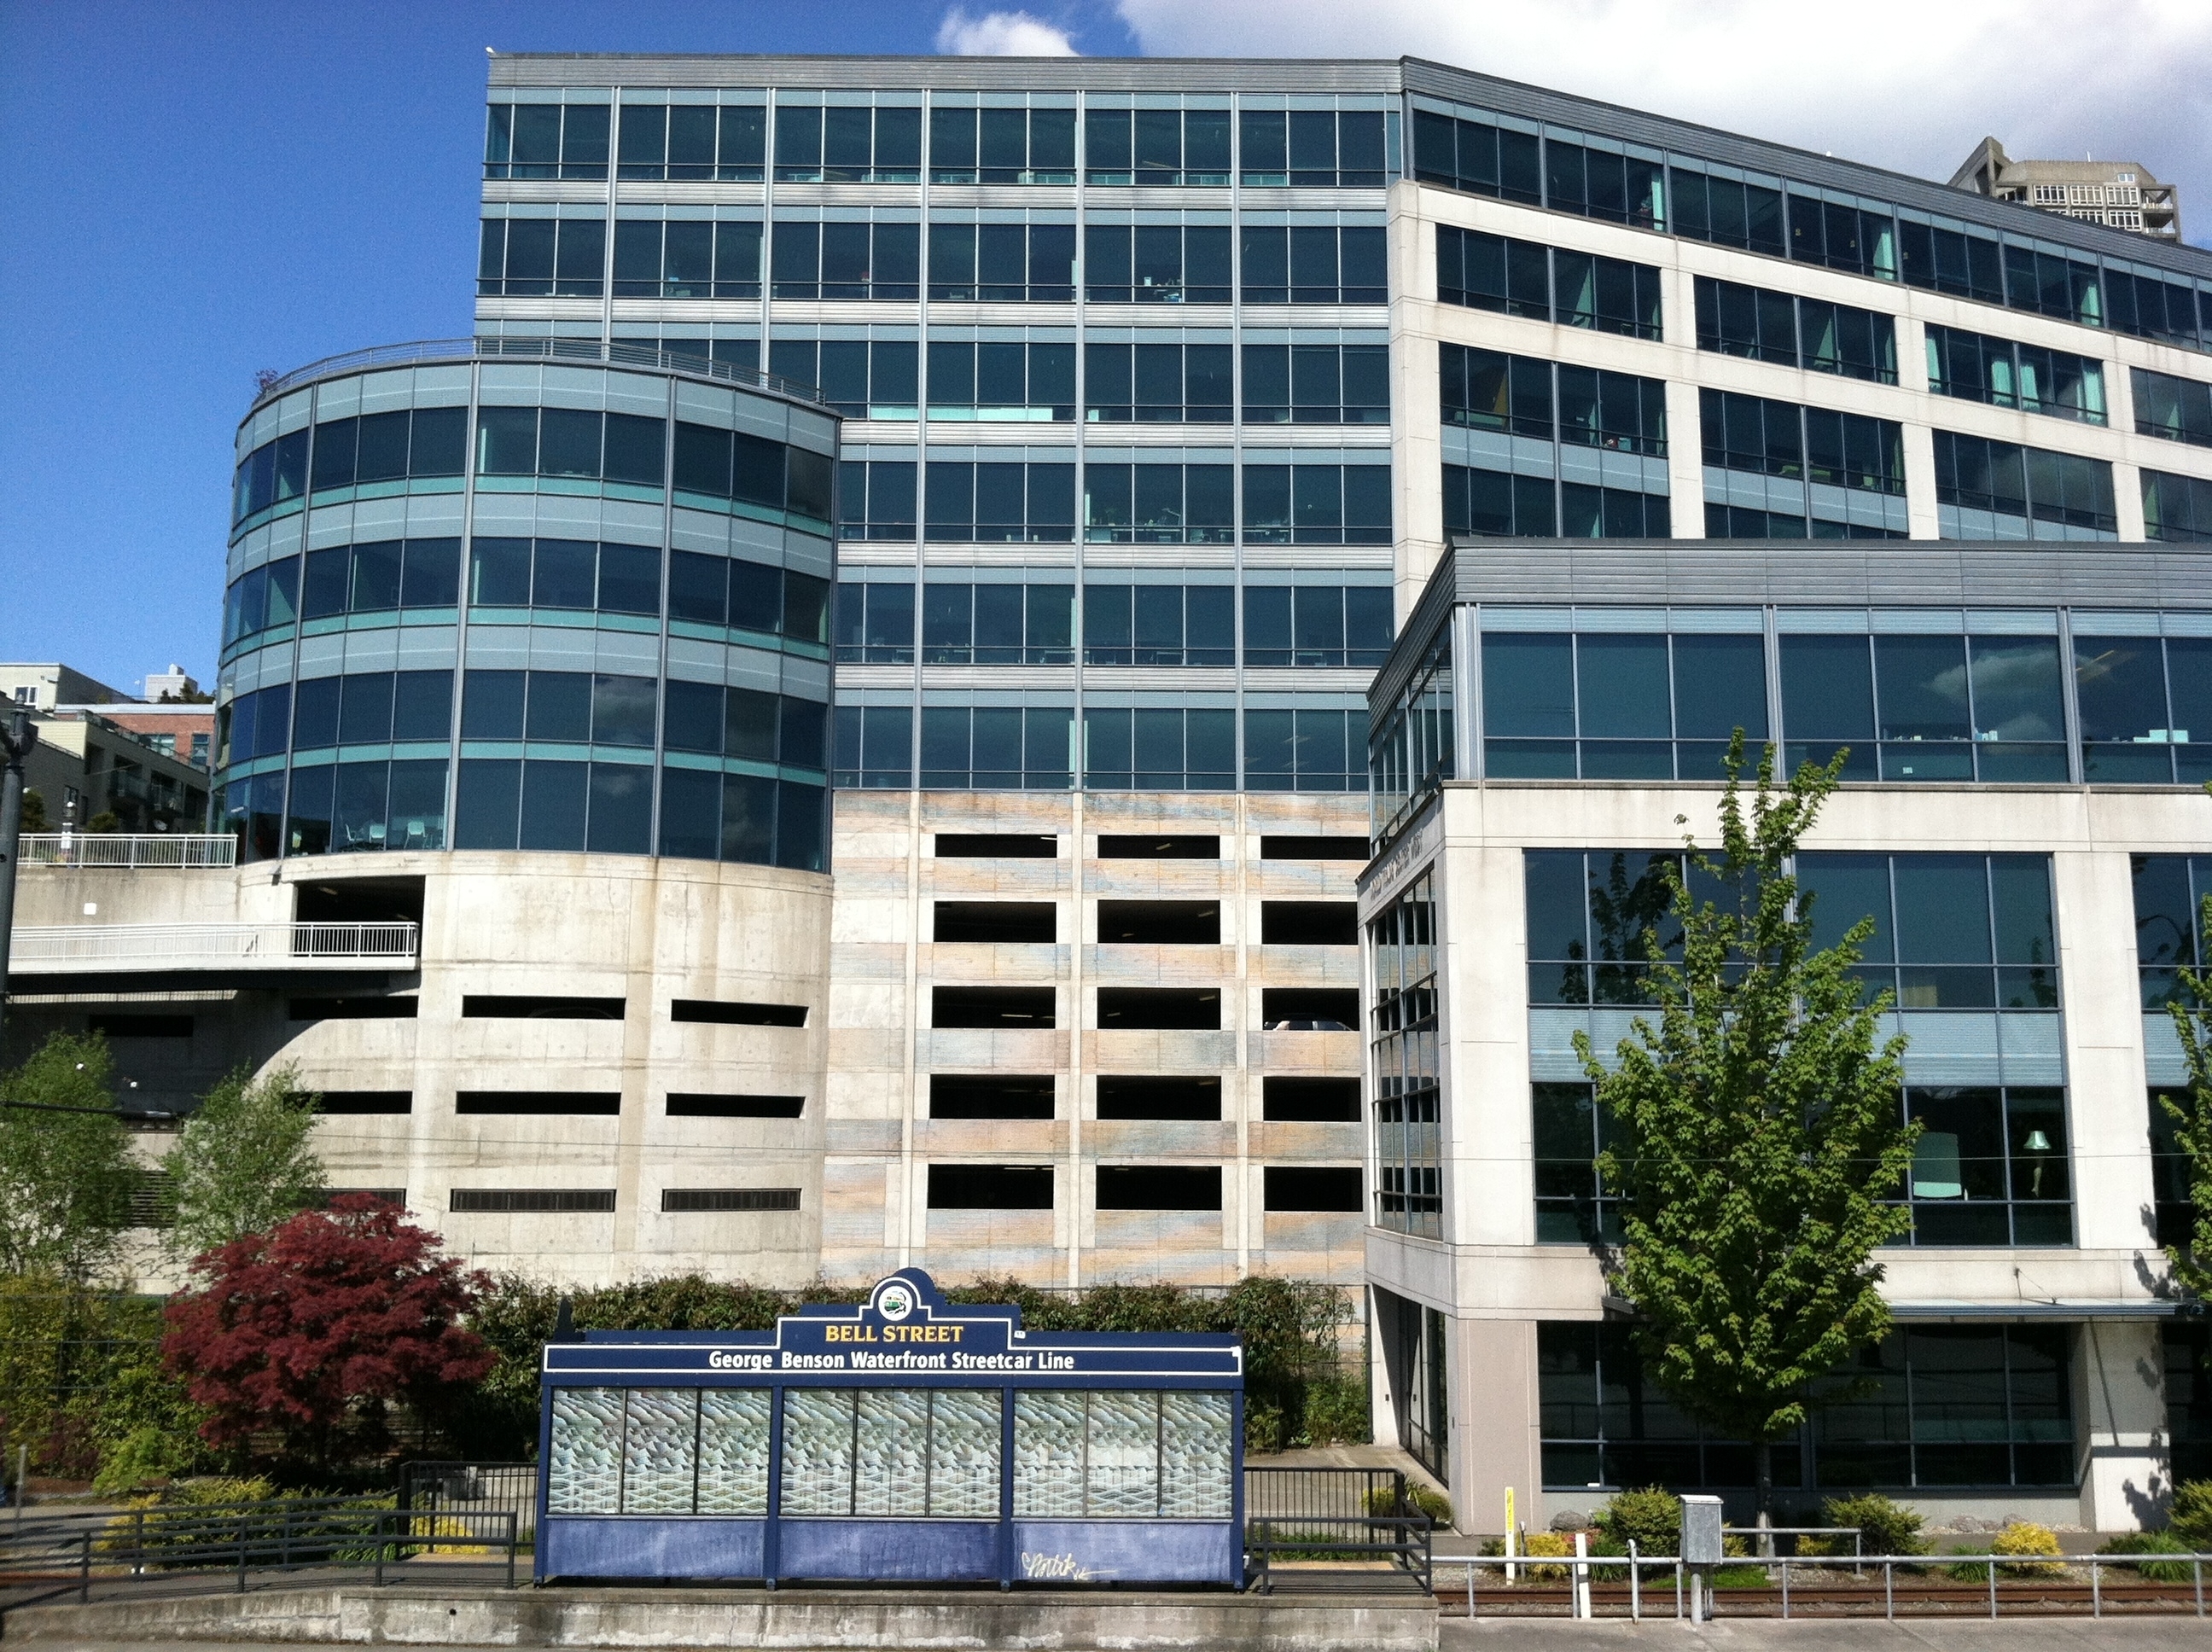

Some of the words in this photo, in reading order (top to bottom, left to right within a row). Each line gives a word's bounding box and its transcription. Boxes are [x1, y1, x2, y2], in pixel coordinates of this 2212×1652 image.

[825, 1324, 878, 1342] BELL
[882, 1324, 964, 1342] STREET
[708, 1350, 773, 1370] George
[781, 1351, 845, 1369] Benson
[850, 1350, 946, 1370] Waterfront
[952, 1351, 1033, 1370] Streetcar
[1038, 1351, 1074, 1370] Line
